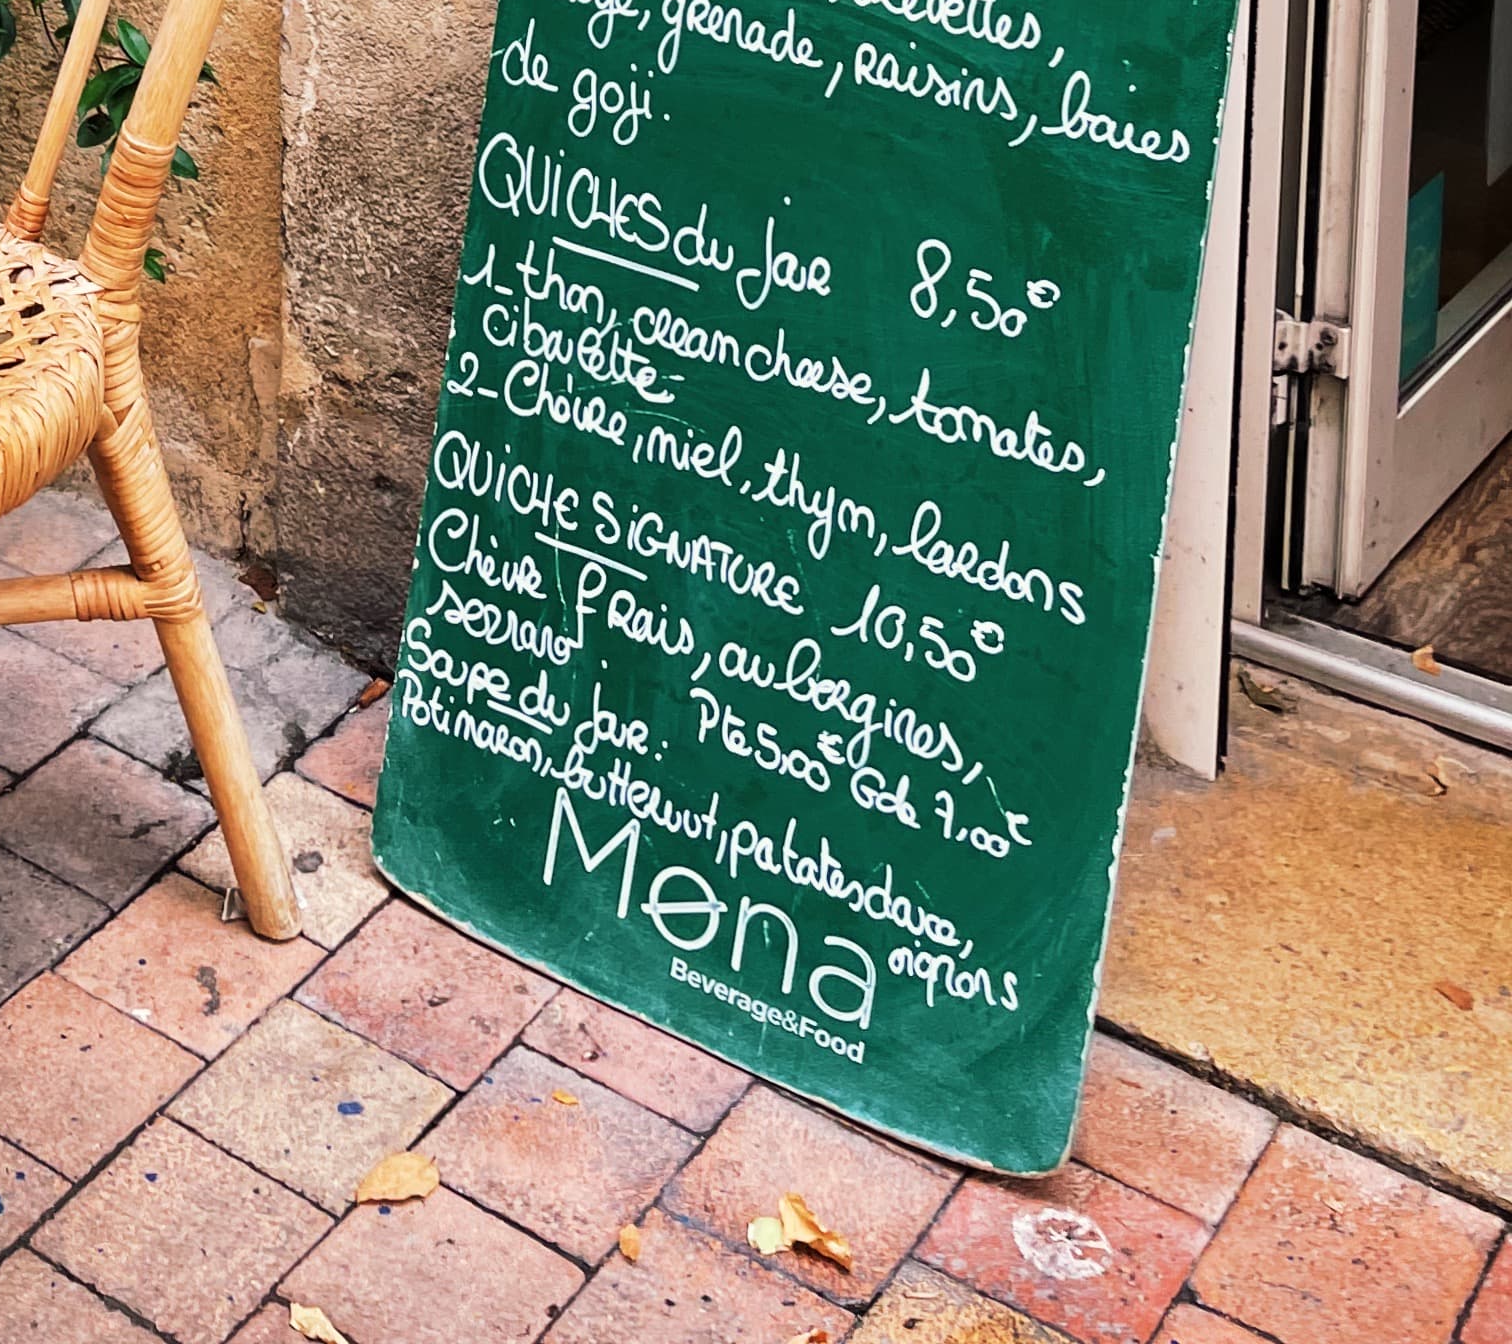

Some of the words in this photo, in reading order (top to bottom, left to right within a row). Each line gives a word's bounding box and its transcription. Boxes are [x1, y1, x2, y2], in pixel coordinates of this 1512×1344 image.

[500, 18, 559, 92] de
[1042, 70, 1190, 163] baies
[478, 132, 669, 253] QUICHES
[672, 203, 734, 270] du
[893, 501, 1086, 624] lardons
[669, 957, 866, 1065] Beverage&Food
